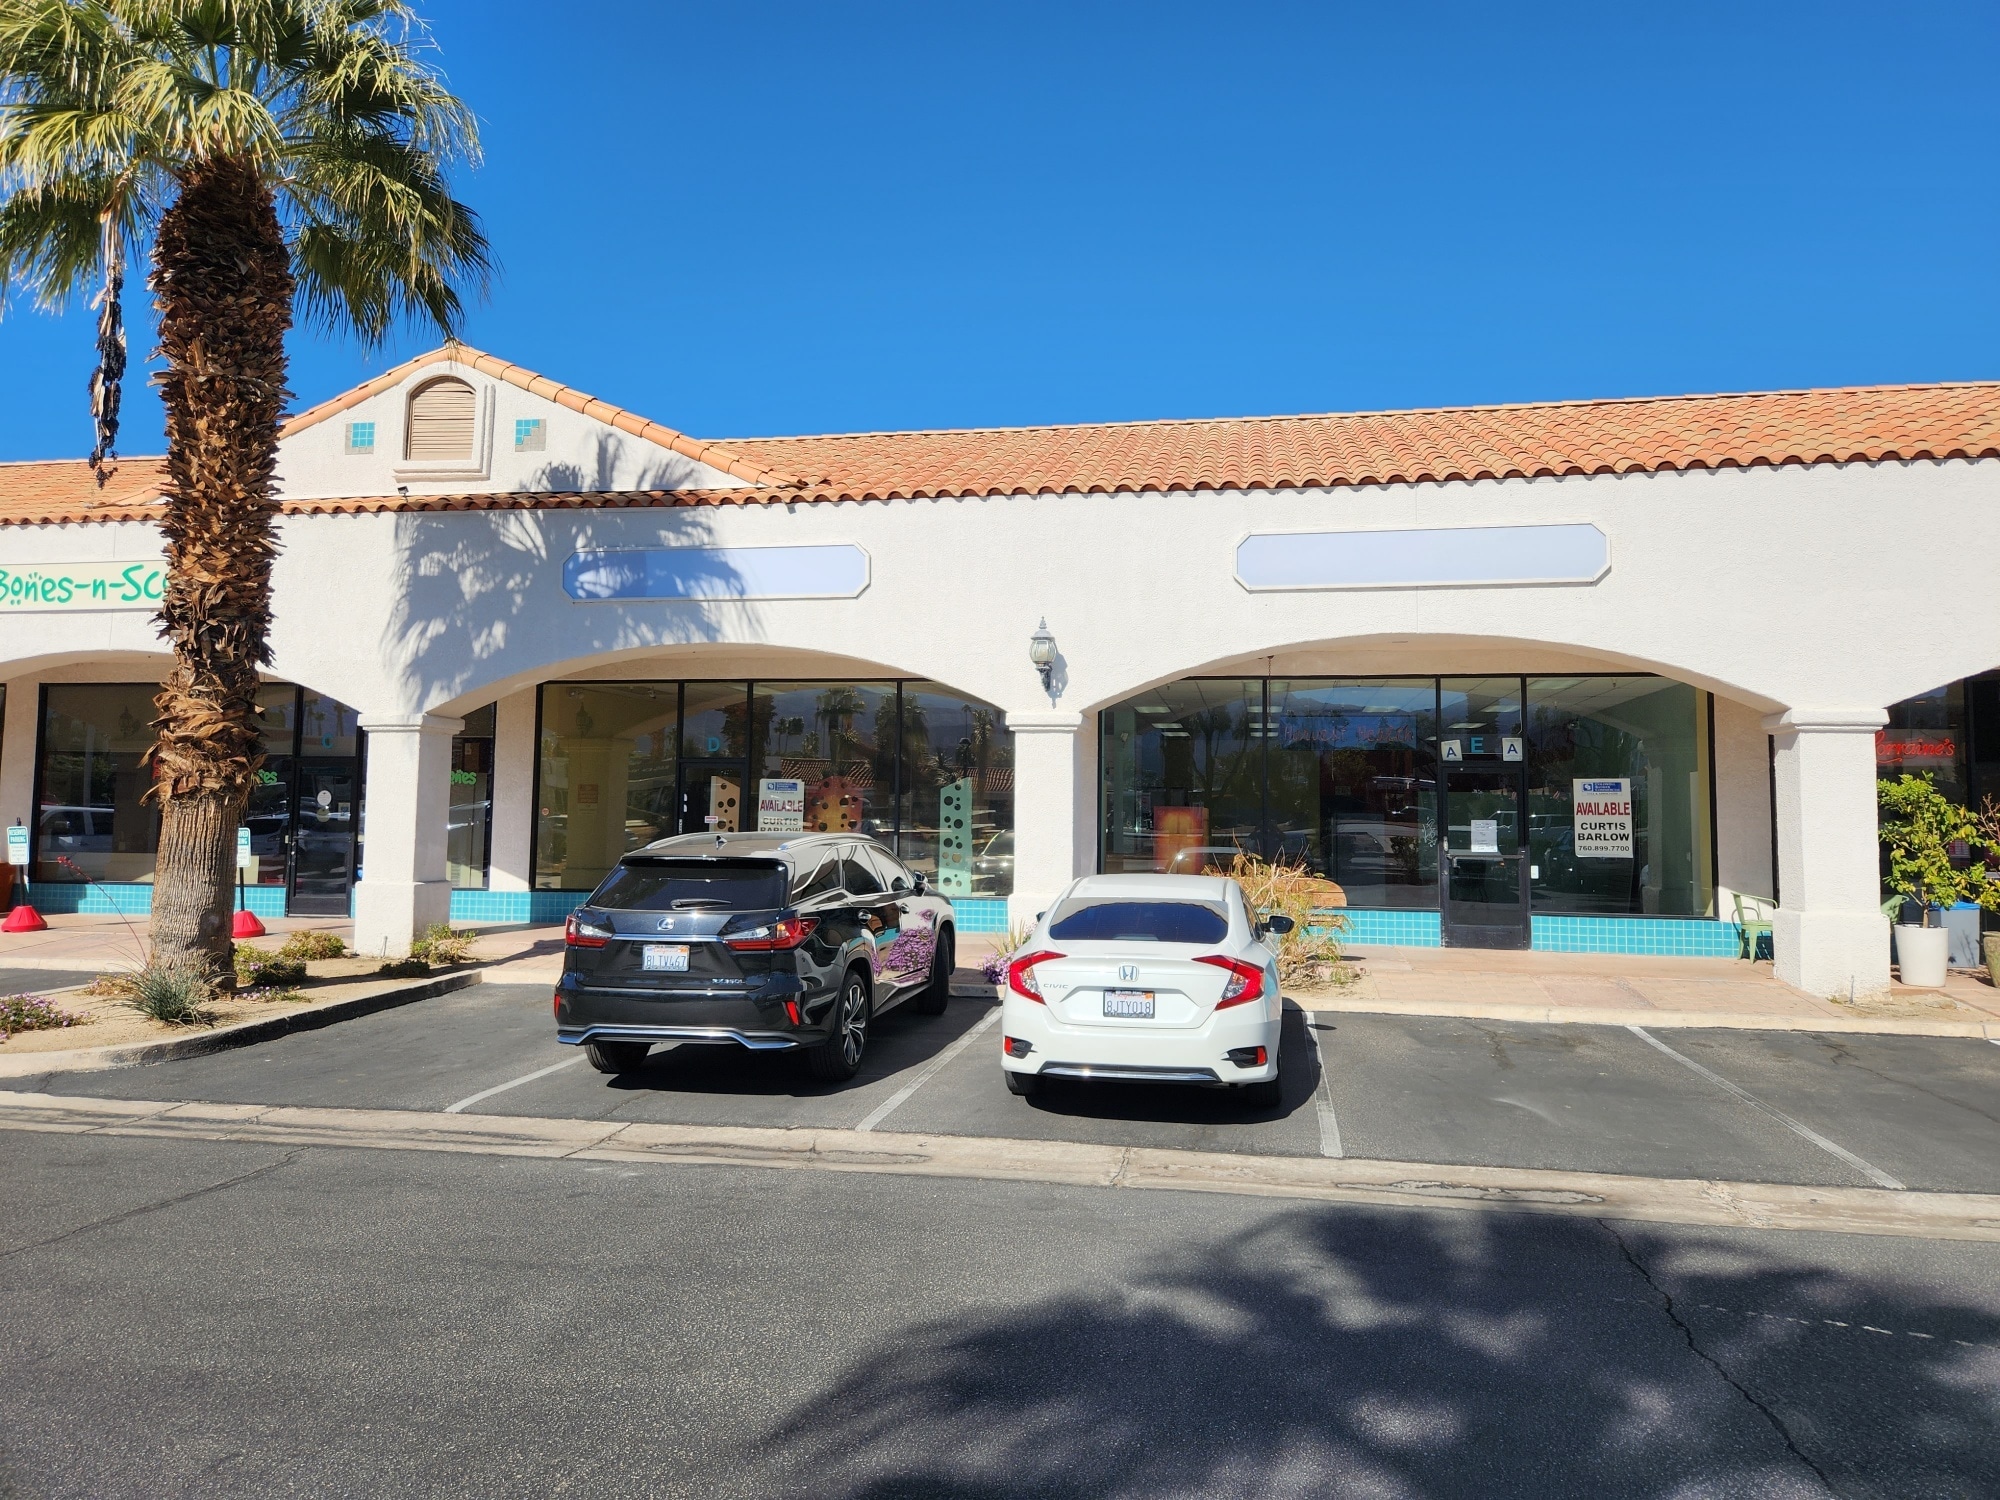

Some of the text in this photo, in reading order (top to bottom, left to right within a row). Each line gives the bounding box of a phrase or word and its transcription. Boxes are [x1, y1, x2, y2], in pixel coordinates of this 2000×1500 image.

[0, 564, 167, 606] Bones-n-Sc
[321, 732, 334, 749] C
[708, 737, 720, 752] D
[1470, 736, 1484, 754] E
[1446, 746, 1457, 758] A
[1507, 743, 1519, 755] A
[760, 799, 804, 812] AVAILABLE
[1576, 802, 1630, 815] AVAILABLE
[763, 817, 799, 825] CURTIS
[1580, 822, 1627, 831] CURTIS
[1577, 832, 1630, 841] BARLOW
[646, 955, 687, 968] 8LTV467
[1106, 1000, 1151, 1014] 8JTY018
